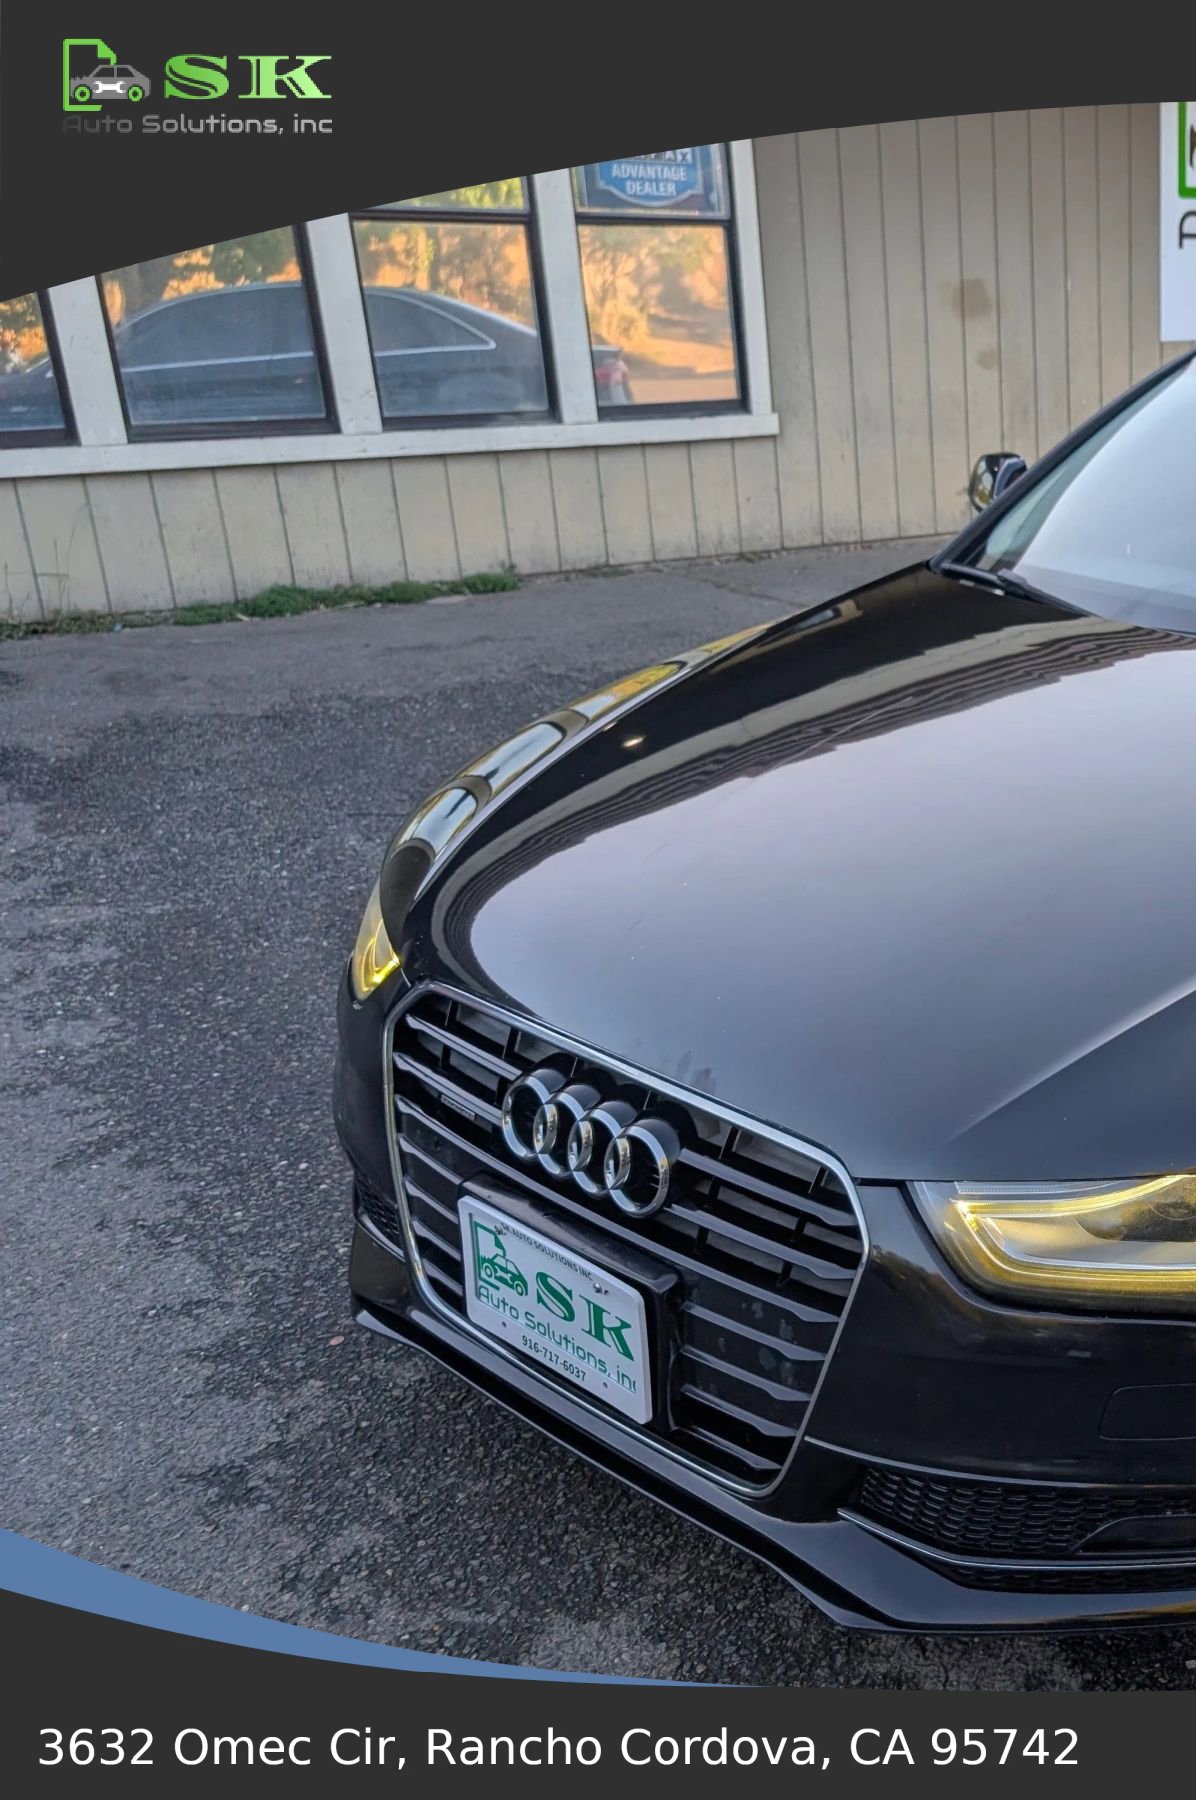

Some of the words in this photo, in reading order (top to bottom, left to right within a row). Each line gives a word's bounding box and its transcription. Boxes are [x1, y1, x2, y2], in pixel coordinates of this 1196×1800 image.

[612, 163, 688, 181] ADVANTAGE
[625, 180, 677, 196] DEALER
[533, 1241, 578, 1272] SOLUTIONS
[479, 1285, 520, 1320] Auto
[524, 1311, 611, 1378] Solutions,
[536, 1271, 635, 1361] SK
[521, 1335, 586, 1382] 916-717-6037
